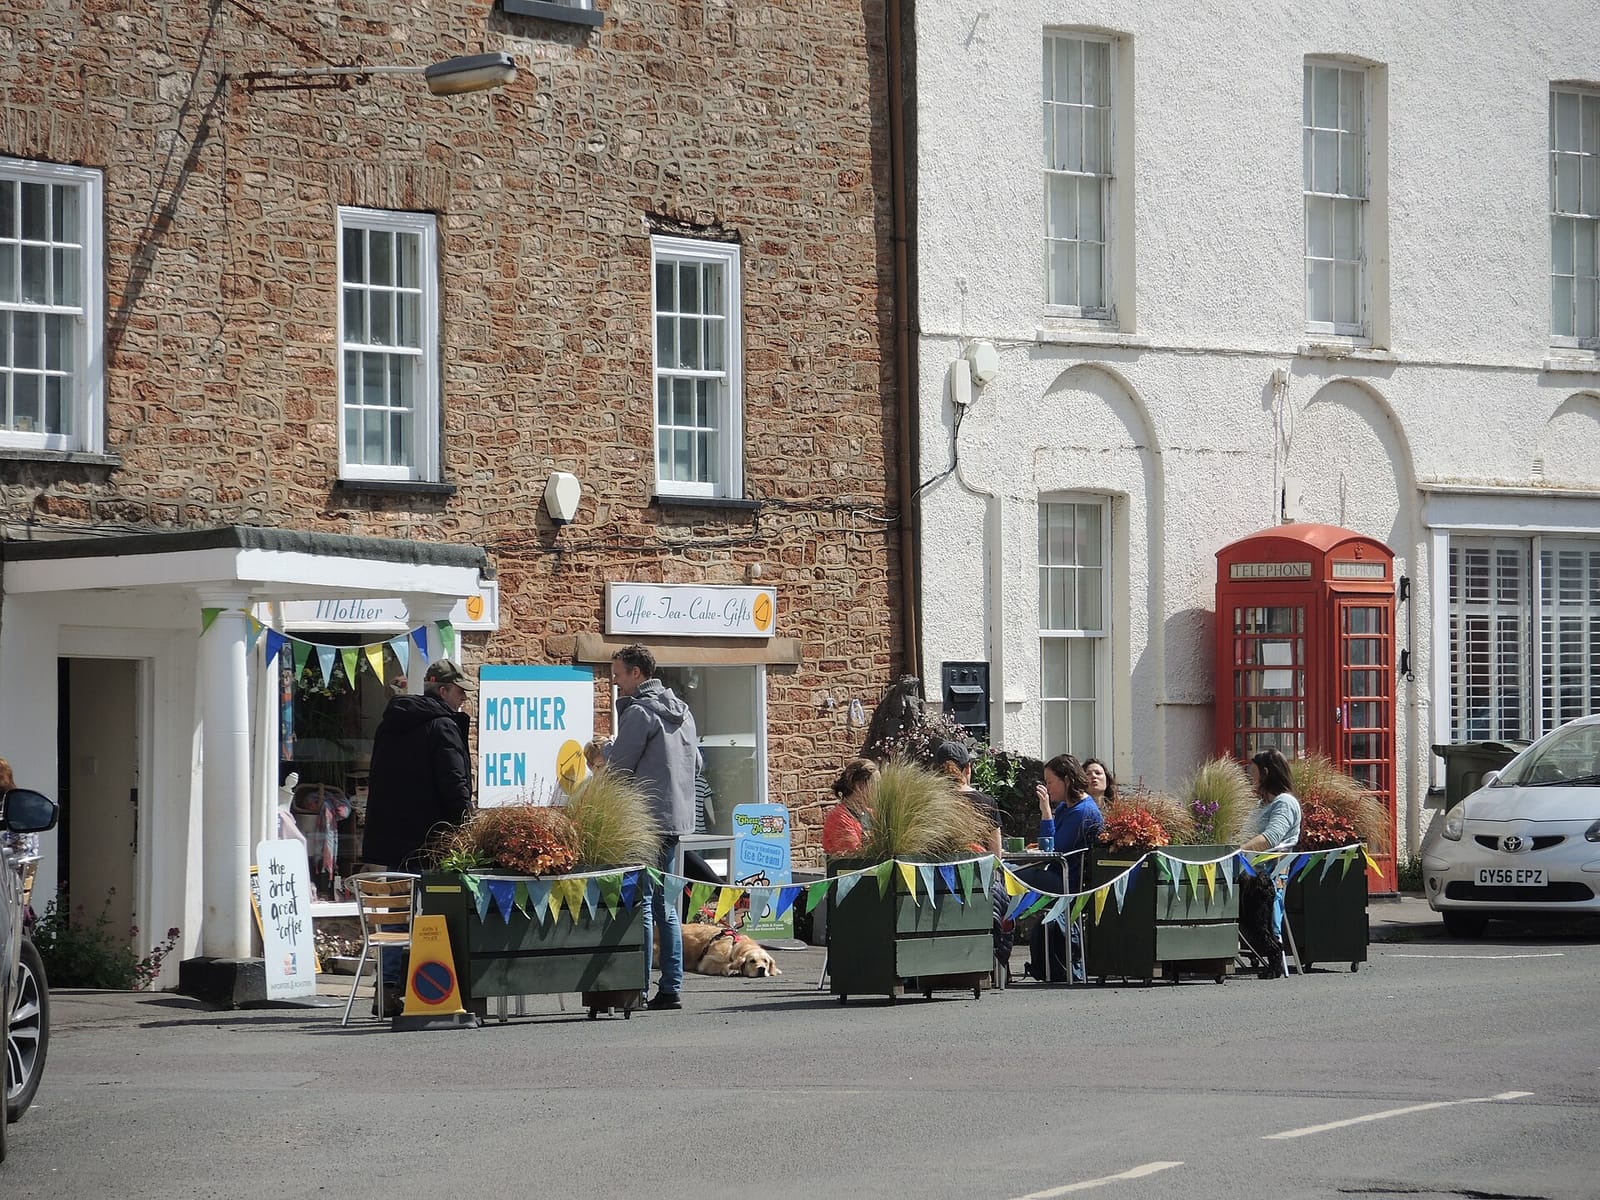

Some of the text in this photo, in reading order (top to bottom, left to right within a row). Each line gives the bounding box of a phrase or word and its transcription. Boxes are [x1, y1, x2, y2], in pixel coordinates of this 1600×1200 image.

[1234, 563, 1309, 577] TELEPHONE
[1334, 563, 1384, 577] TELEPHONE
[315, 600, 383, 620] Mother
[486, 696, 566, 731] MOTHER
[485, 752, 526, 787] HEN
[268, 857, 286, 875] the
[757, 852, 780, 866] Cream
[1480, 869, 1543, 883] GY56 EPZ
[271, 896, 298, 930] great
[279, 917, 303, 946] coffee
